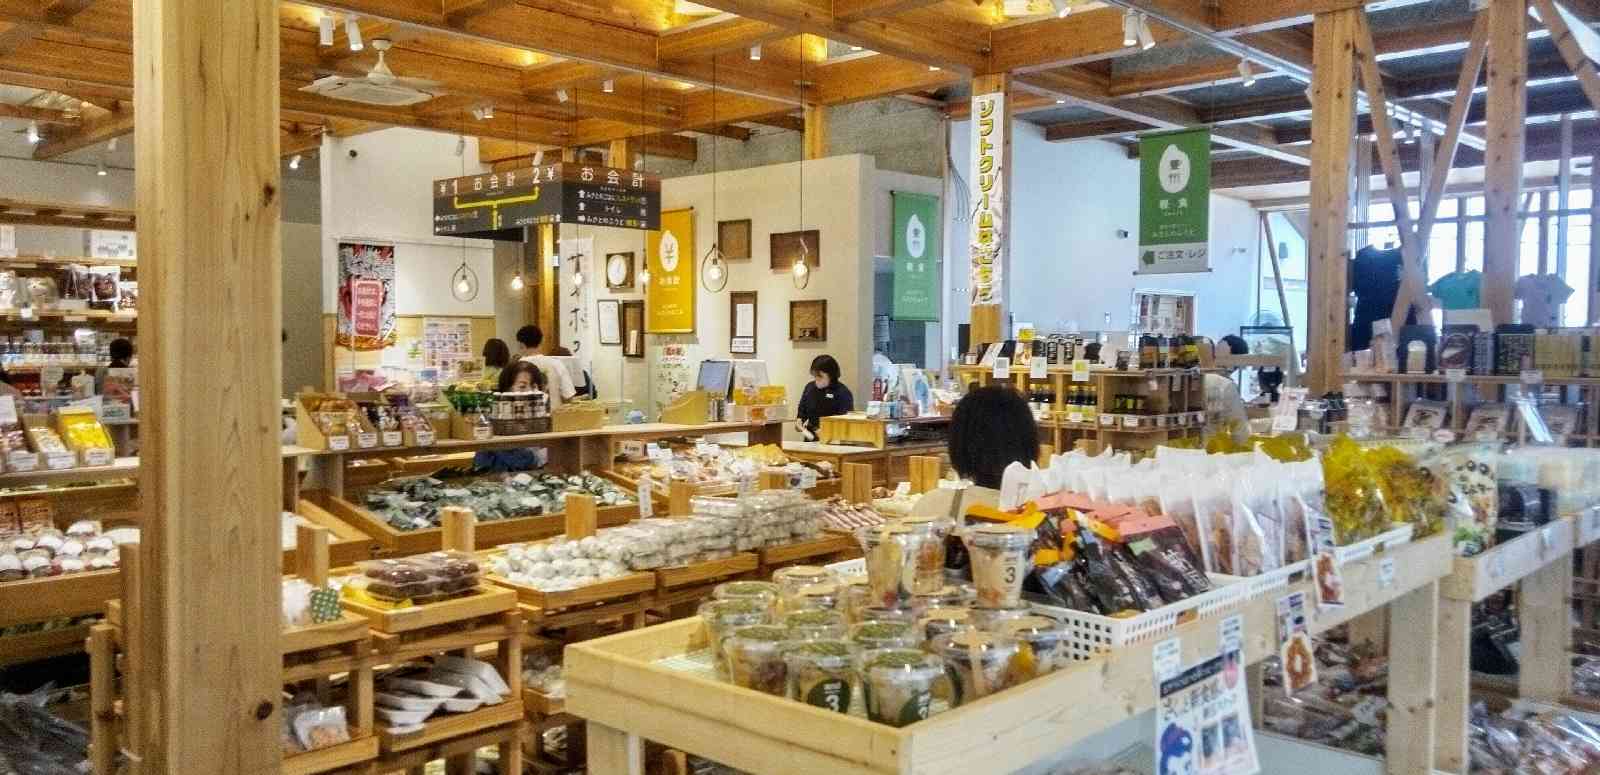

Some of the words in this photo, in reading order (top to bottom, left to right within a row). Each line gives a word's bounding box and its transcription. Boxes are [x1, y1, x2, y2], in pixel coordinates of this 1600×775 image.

[532, 167, 540, 184] 2
[580, 166, 645, 188] お会計
[1004, 565, 1017, 584] 3
